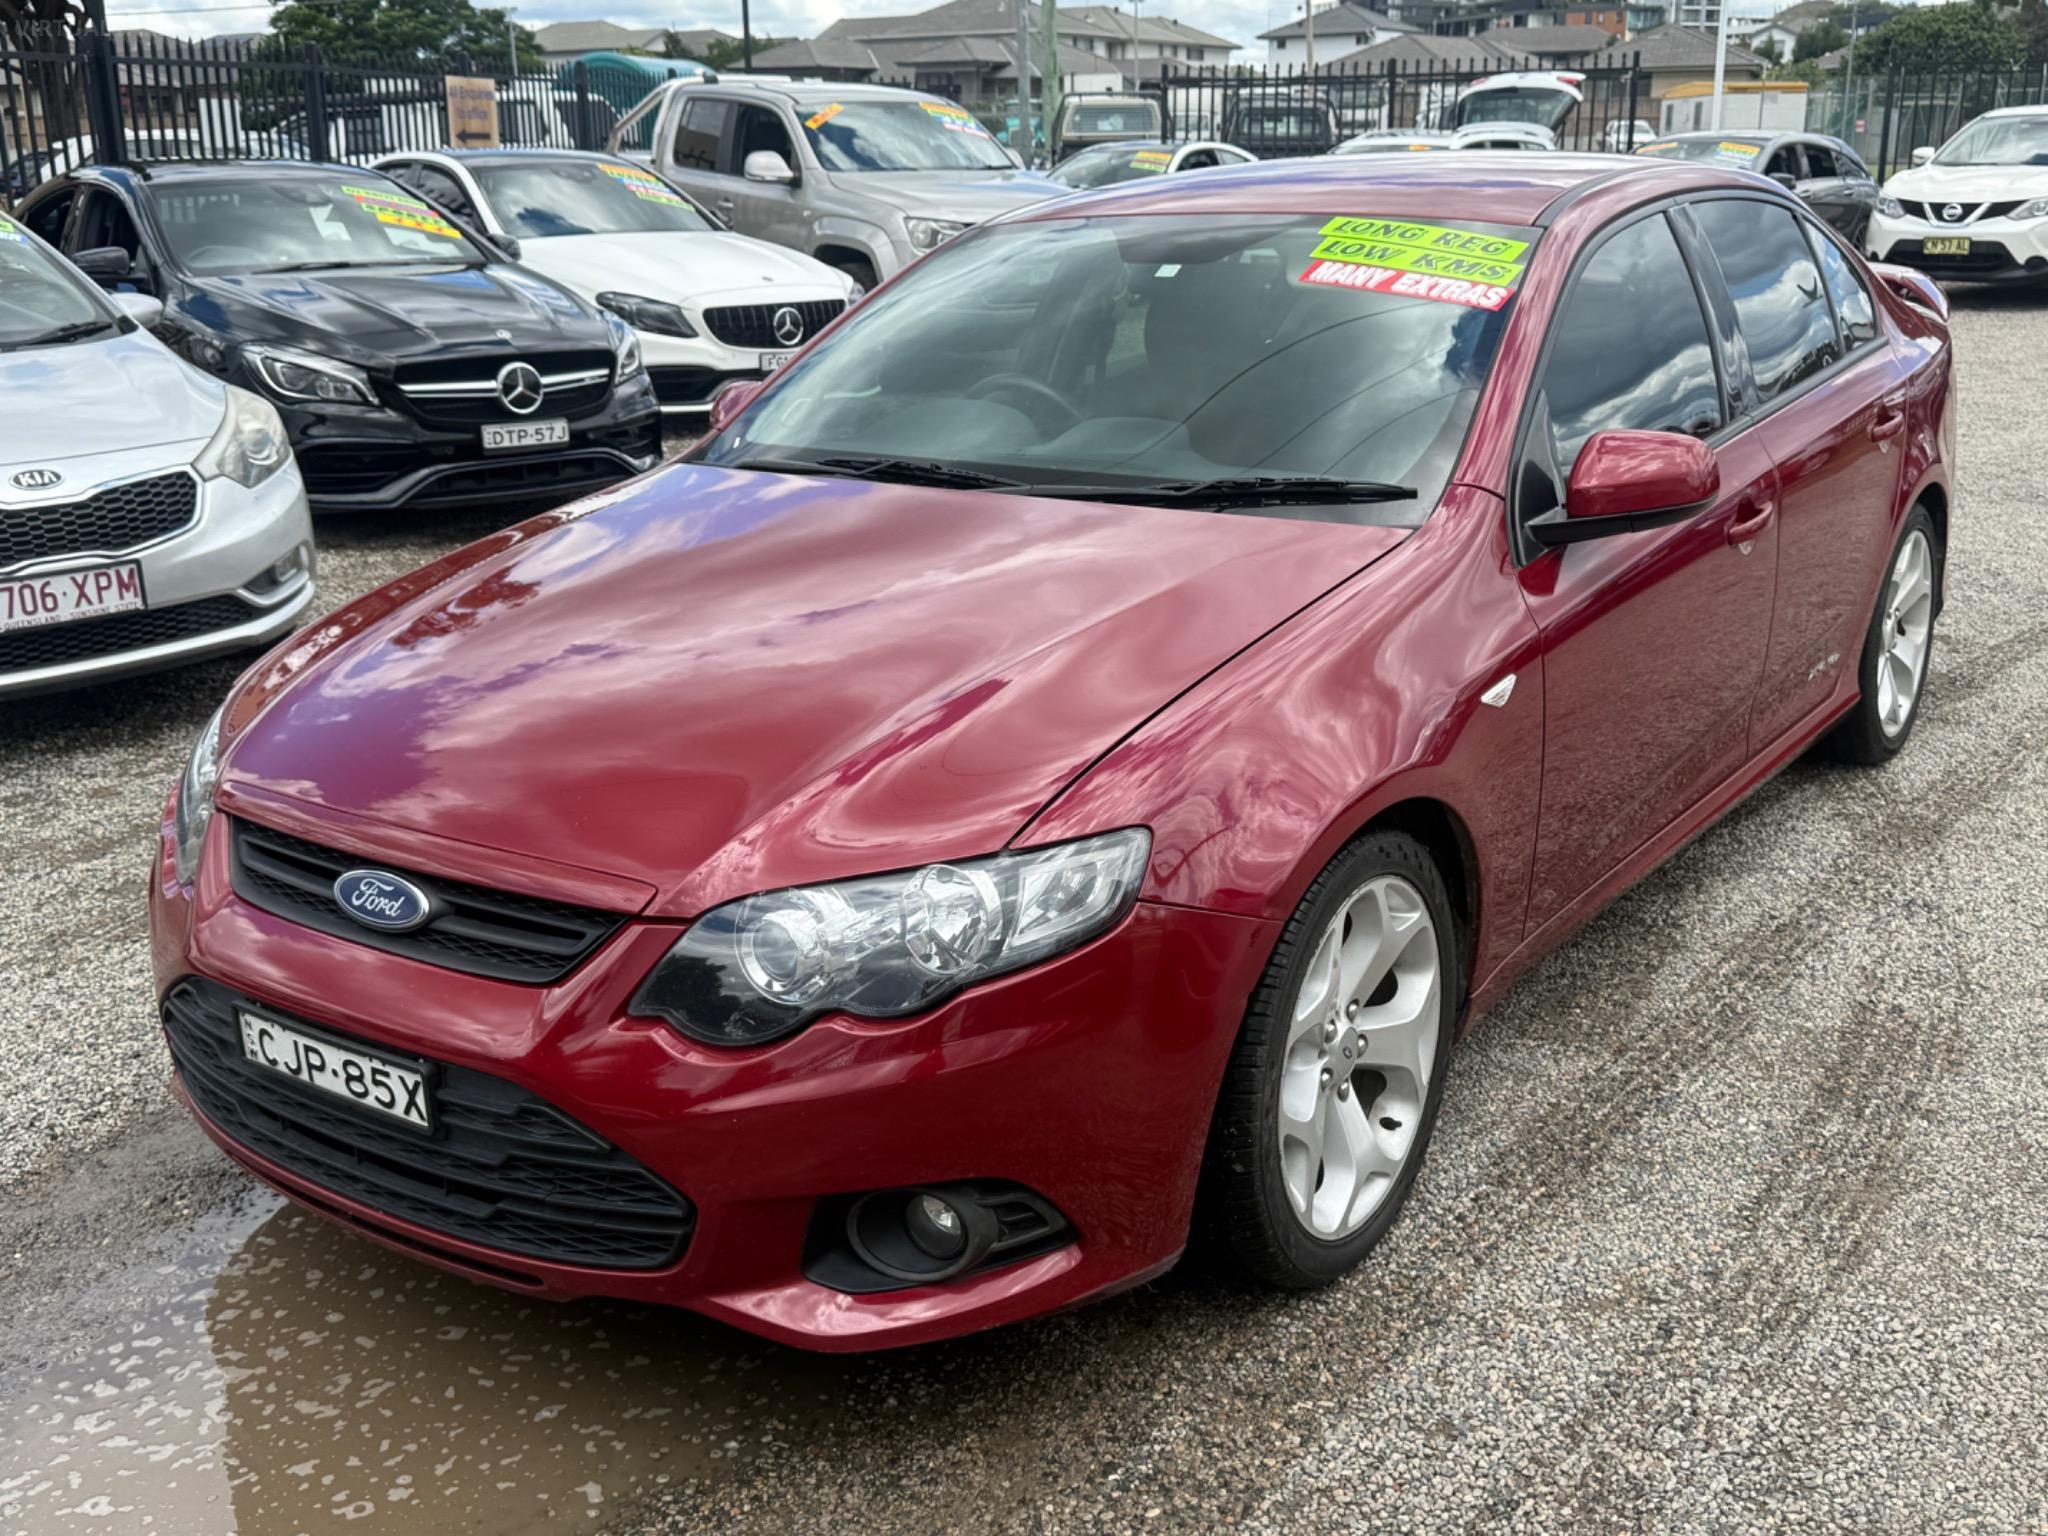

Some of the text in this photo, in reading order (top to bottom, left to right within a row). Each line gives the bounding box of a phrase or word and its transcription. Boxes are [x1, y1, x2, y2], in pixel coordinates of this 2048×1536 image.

[1333, 220, 1513, 256] LONG REG
[1321, 240, 1508, 280] LOW KMS
[1309, 261, 1507, 308] MANY EXTRAS
[17, 471, 57, 487] KIA
[351, 878, 405, 917] Ford
